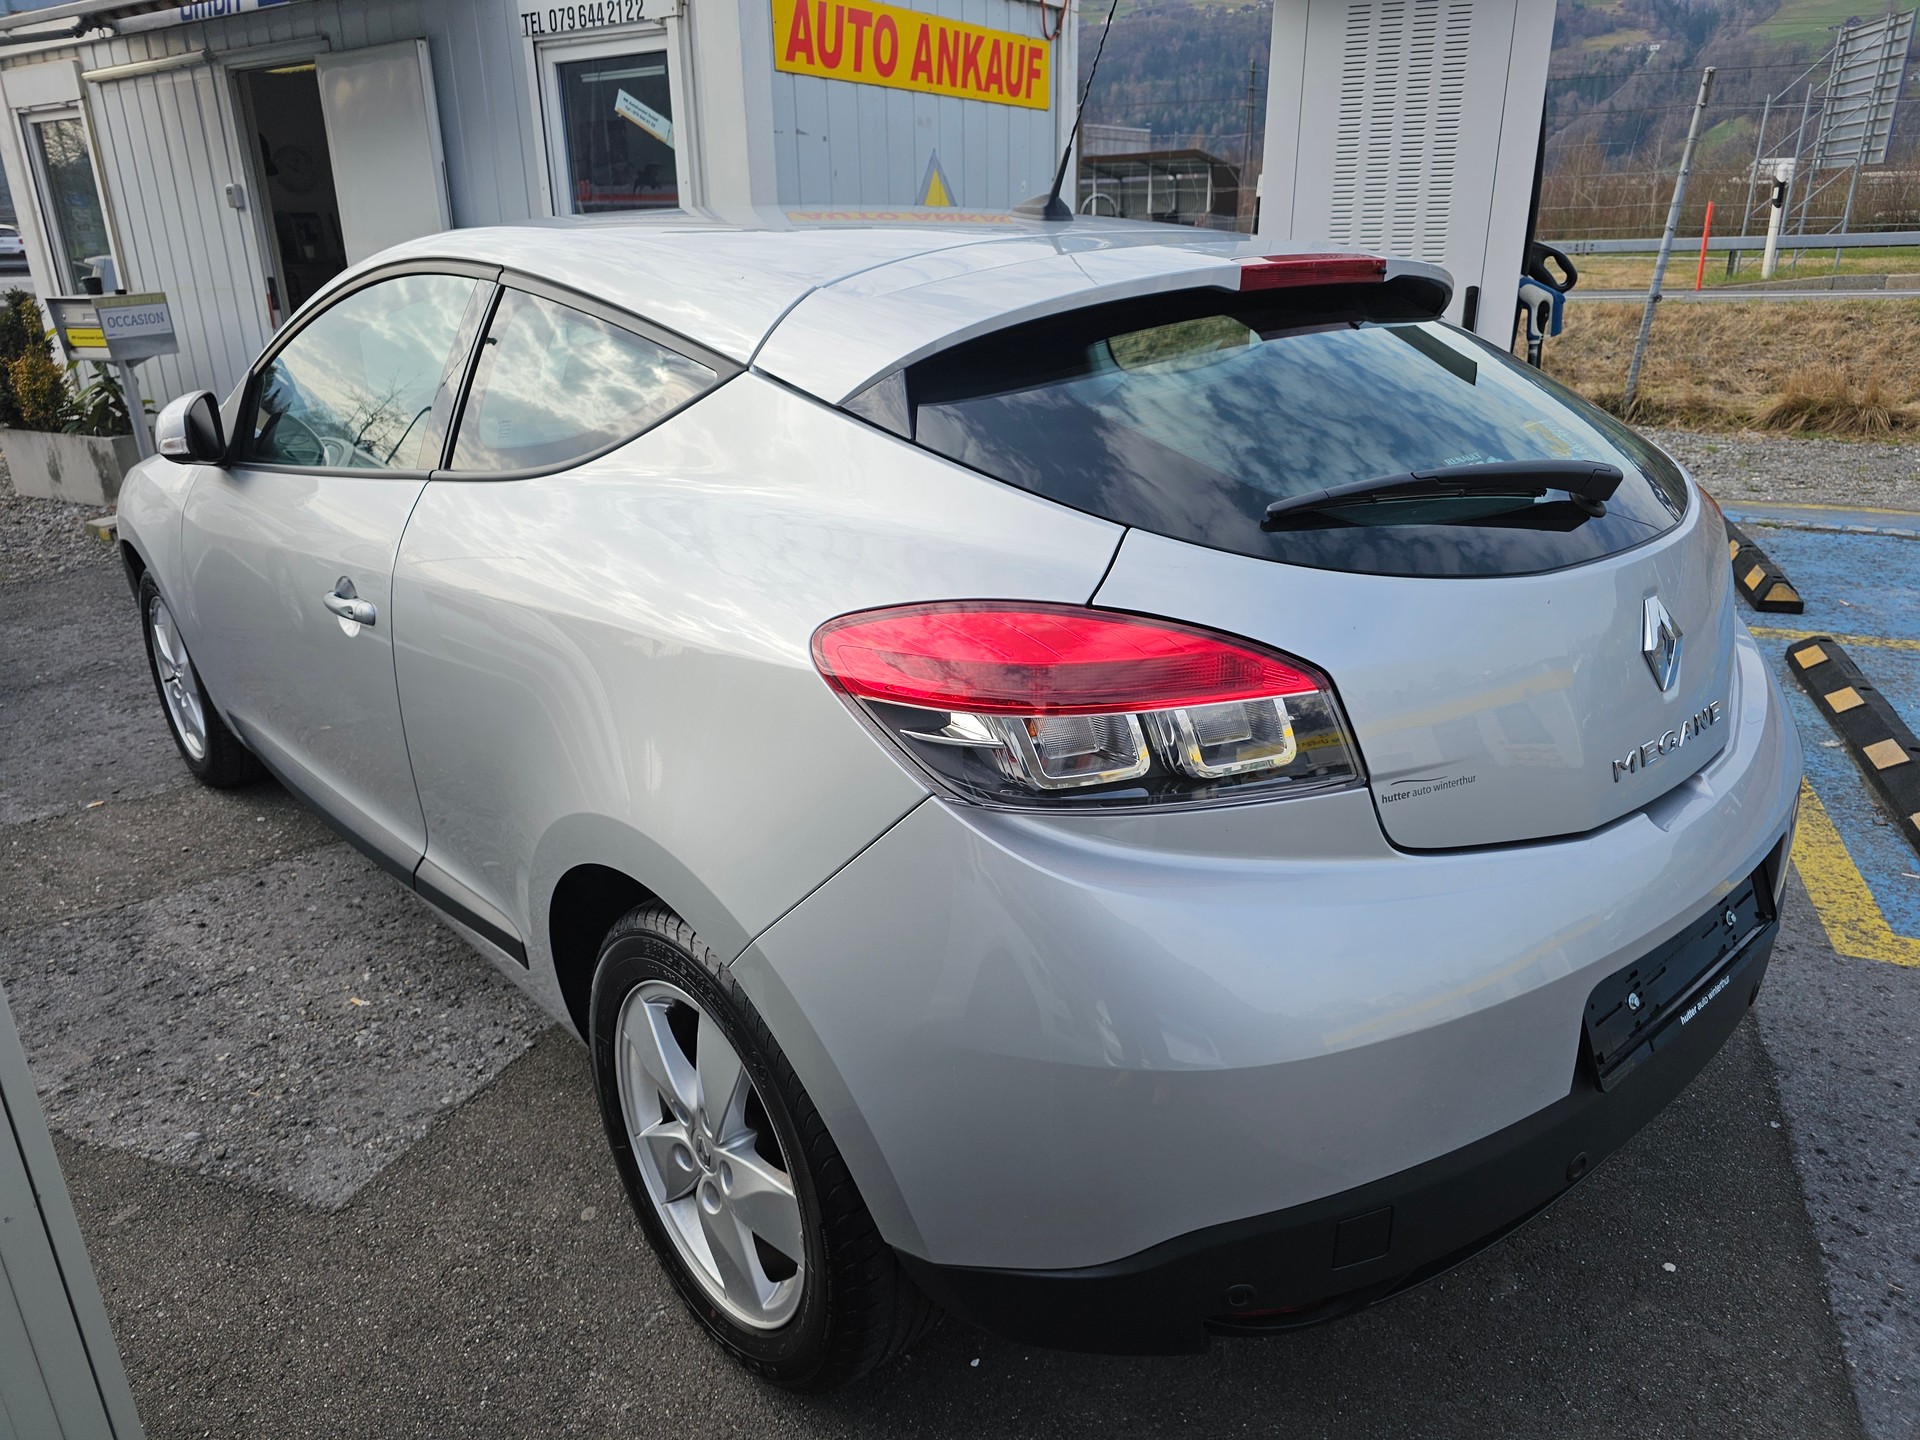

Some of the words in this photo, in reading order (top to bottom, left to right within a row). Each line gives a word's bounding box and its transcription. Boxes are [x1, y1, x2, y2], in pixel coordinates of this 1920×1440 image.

[521, 11, 545, 36] TEL
[549, 6, 575, 32] 079
[578, 3, 604, 28] 644
[785, 0, 899, 78] AUTO
[910, 24, 1043, 98] ANKAUF
[107, 312, 164, 328] OCCASION
[1444, 452, 1482, 466] RENAULT
[1612, 700, 1720, 783] MEGANE
[1381, 790, 1411, 804] hutter
[1412, 786, 1432, 797] auto
[1433, 775, 1477, 793] winterthur
[1680, 1005, 1697, 1026] hutter
[1697, 996, 1709, 1011] auto
[1708, 975, 1730, 1000] winterthur
